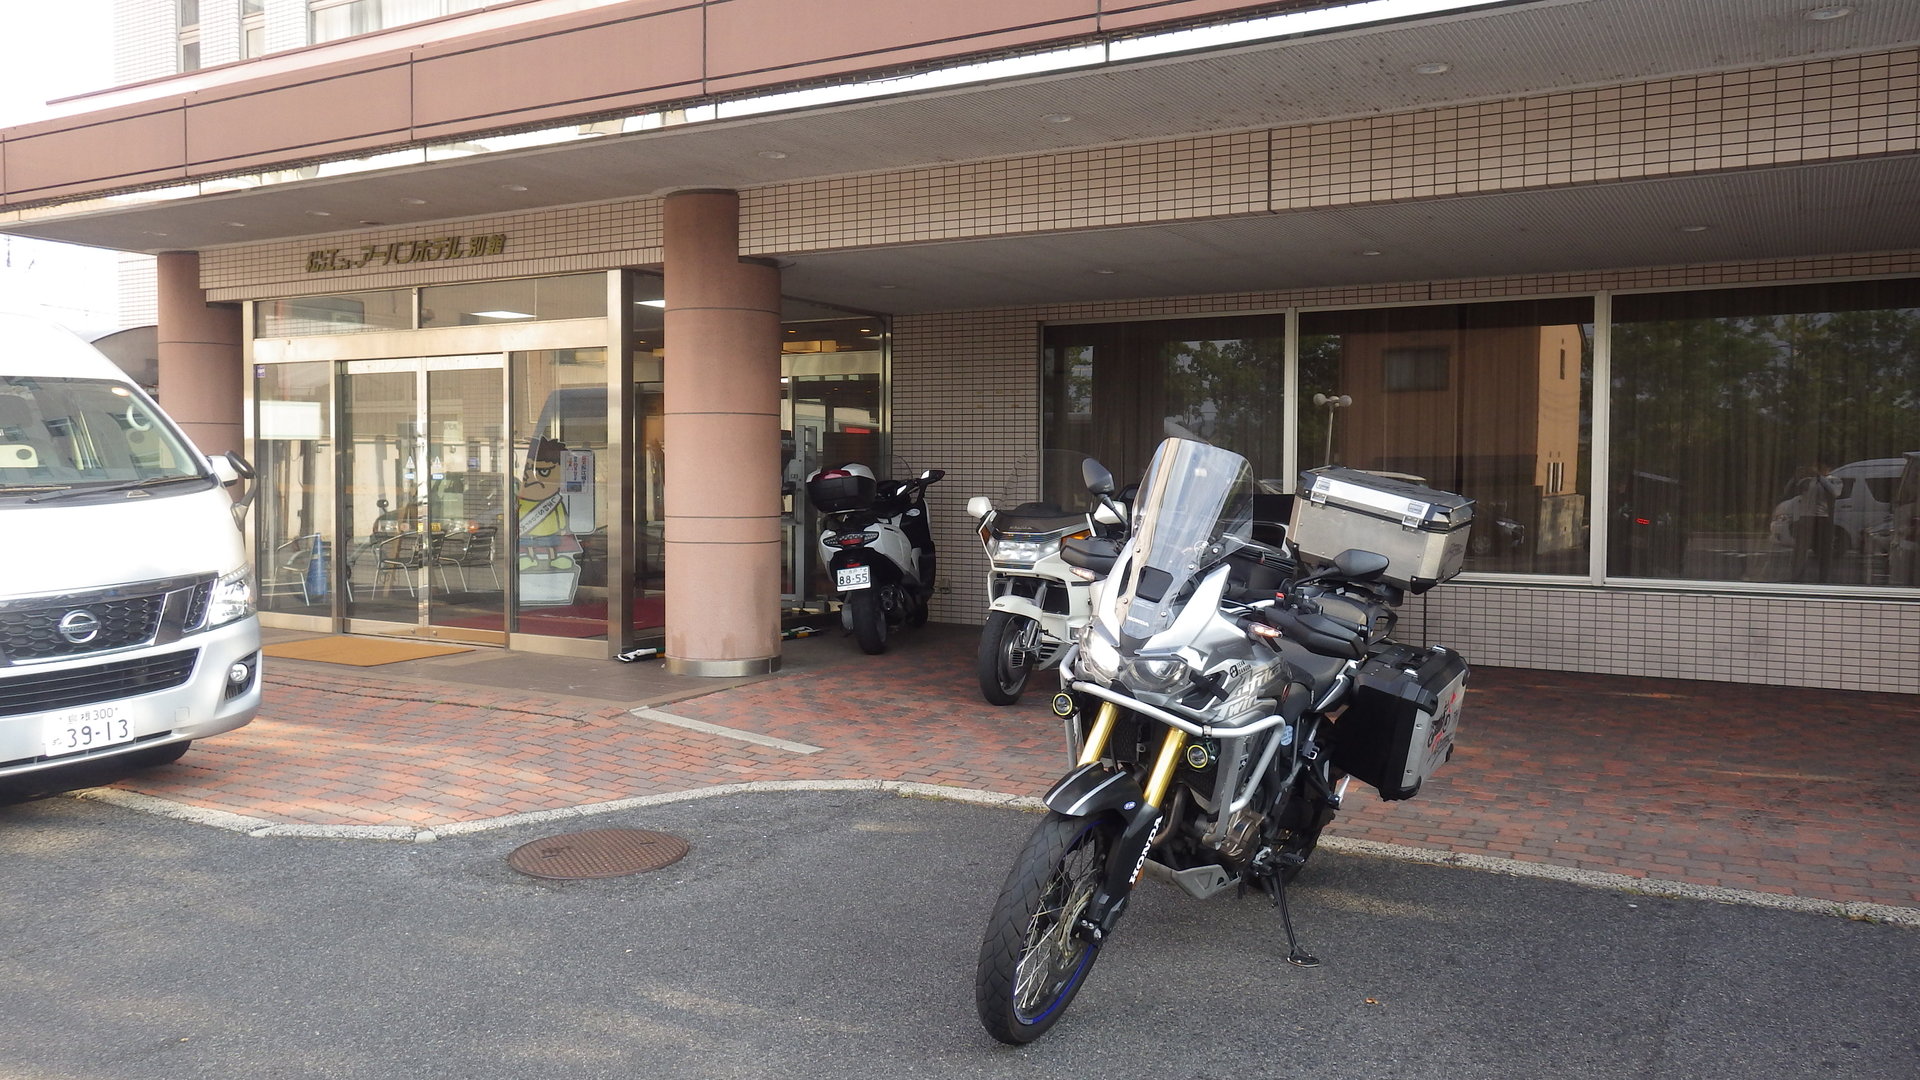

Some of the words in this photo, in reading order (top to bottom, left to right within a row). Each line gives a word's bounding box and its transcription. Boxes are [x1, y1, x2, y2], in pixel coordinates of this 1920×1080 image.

[93, 707, 114, 721] 300
[66, 719, 128, 748] 39-13
[1128, 815, 1164, 885] HONDA
